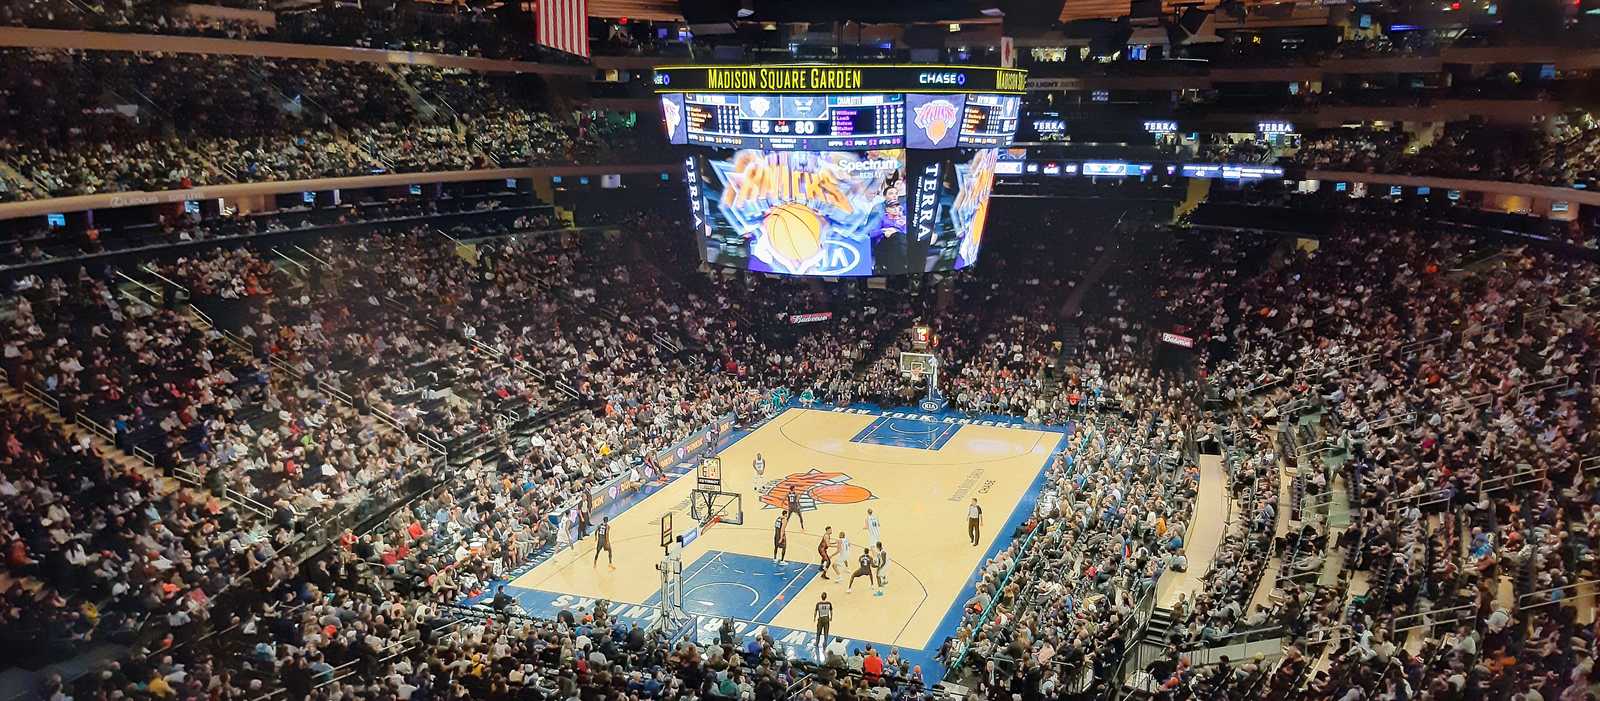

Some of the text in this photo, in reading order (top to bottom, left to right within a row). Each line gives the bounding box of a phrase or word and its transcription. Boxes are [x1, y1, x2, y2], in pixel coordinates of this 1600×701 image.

[708, 68, 861, 90] MADISON SQUARE GARDEN
[919, 74, 956, 84] CHASE
[752, 120, 770, 134] 55
[795, 121, 815, 135] 80
[1033, 122, 1065, 130] TERRA
[1144, 122, 1177, 131] TERRA
[1258, 123, 1293, 132] TERRA
[838, 159, 897, 173] Spectrum
[685, 156, 703, 231] TERRA
[917, 163, 940, 242] TERRA
[832, 407, 871, 415] NEW
